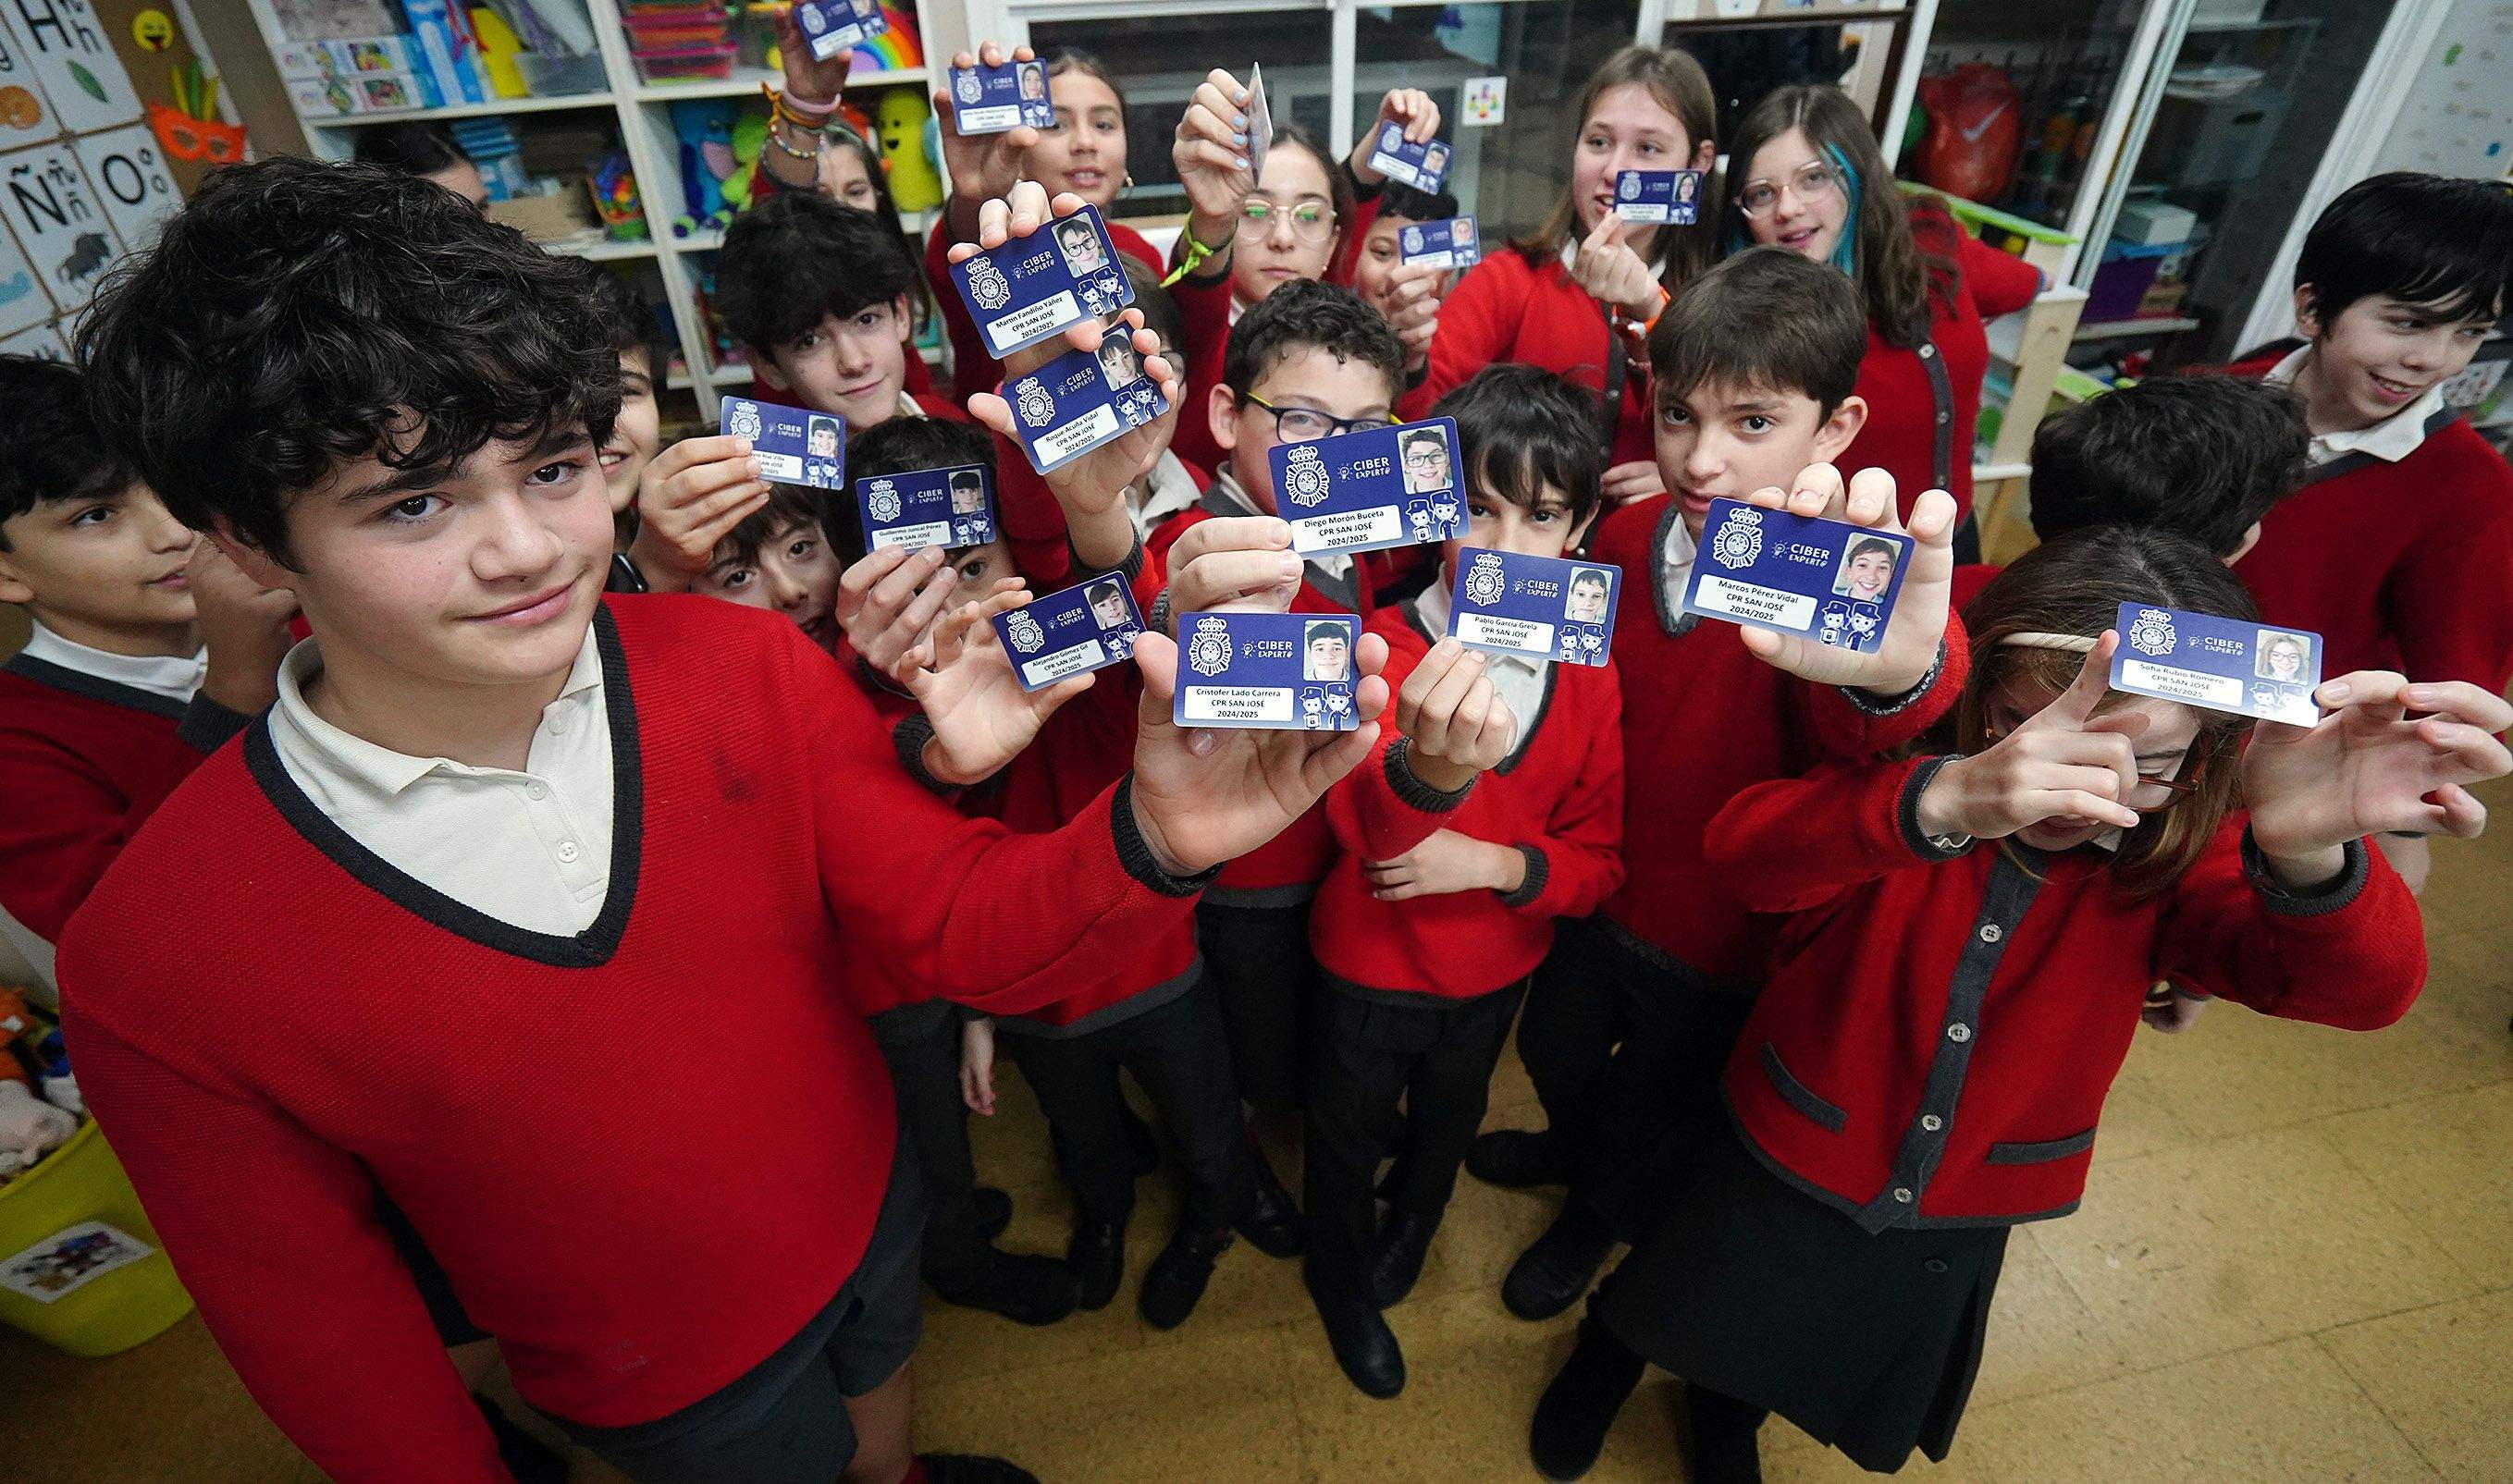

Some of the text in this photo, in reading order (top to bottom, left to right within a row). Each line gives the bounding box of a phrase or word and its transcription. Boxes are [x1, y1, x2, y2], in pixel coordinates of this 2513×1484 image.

[15, 0, 73, 53] H
[69, 18, 103, 55] h
[102, 153, 145, 205] O
[9, 163, 68, 233] Ñ
[1022, 251, 1052, 268] CIBER
[1017, 305, 1042, 318] Fandiño
[1012, 323, 1025, 332] CPR
[1025, 316, 1039, 325] SAN
[1020, 321, 1053, 337] 2024/2025
[1066, 367, 1092, 385] CIBER
[777, 423, 802, 433] CIBER
[1045, 431, 1064, 441] Roque
[1082, 411, 1098, 422] Vidal
[1056, 437, 1067, 447] CPR
[1068, 431, 1080, 440] SAN
[1065, 434, 1094, 452] 2024/2025
[1353, 457, 1389, 471] CIBER
[918, 488, 943, 498] CIBER
[1304, 509, 1384, 528] Diego Morón Buceta
[1319, 527, 1334, 536] CPR
[1336, 524, 1353, 534] SAN
[1326, 534, 1368, 546] 2024/2025
[1790, 543, 1829, 559] CIBER
[1527, 579, 1558, 591] CIBER
[1718, 580, 1798, 603] Marcos Pérez Vidal
[1726, 593, 1784, 611] CPR SAN JOSÉ
[1056, 607, 1083, 620] CIBER
[1730, 604, 1774, 620] 2024/2025
[1474, 616, 1494, 624] Pablo
[1519, 621, 1537, 630] Grela
[1481, 626, 1495, 634] CPR
[1511, 631, 1529, 639] JOSÉ
[1257, 641, 1292, 650] CIBER
[1484, 636, 1521, 646] 2024/2025
[2204, 636, 2244, 649] CIBER
[1032, 655, 1059, 667] Alejandro
[1043, 663, 1056, 671] CPR
[1055, 658, 1068, 667] SAN
[1052, 663, 1080, 676] 2024/2025
[2162, 668, 2187, 677] Rubio
[2189, 673, 2224, 683] Romero
[2151, 674, 2168, 682] CPR
[2170, 678, 2188, 686] SAN
[1196, 688, 1280, 697] Cristofer Lado Carrera
[2158, 683, 2202, 697] 2024/2025
[1211, 699, 1227, 707] CPR
[1228, 699, 1246, 707] SAN
[1217, 710, 1258, 718] 2024/2025
